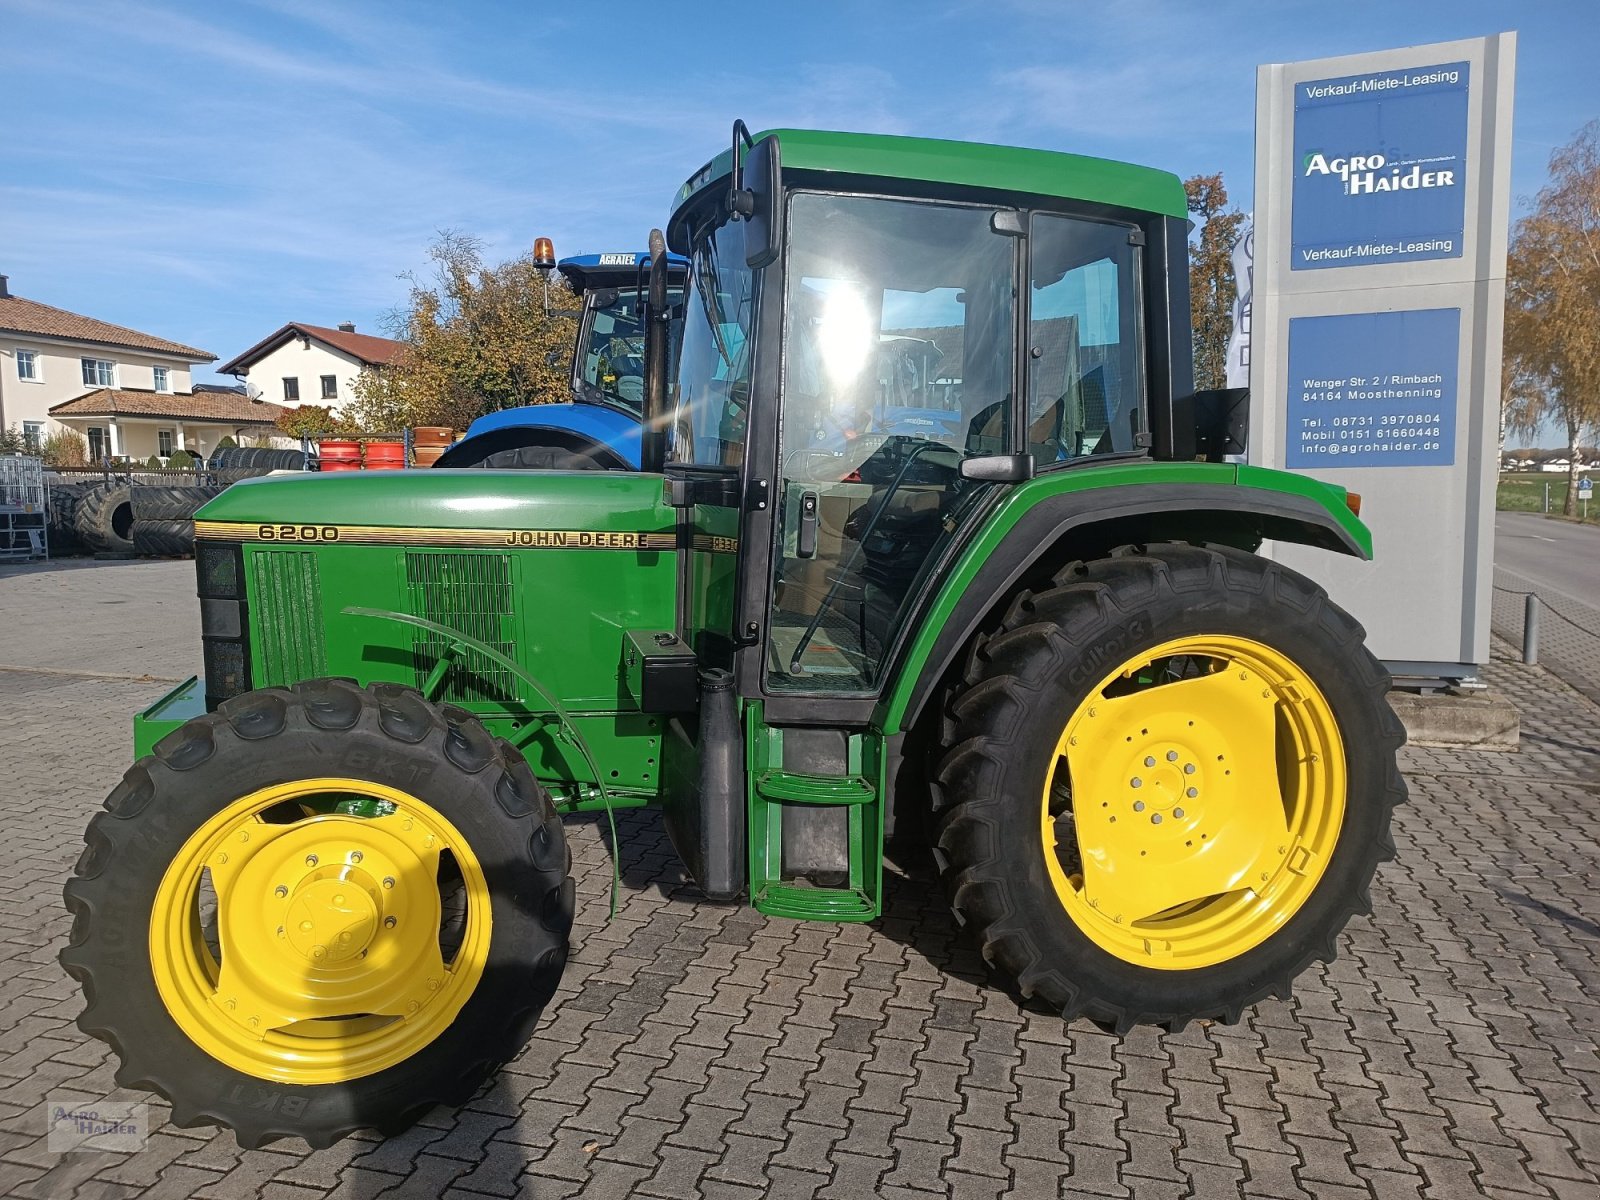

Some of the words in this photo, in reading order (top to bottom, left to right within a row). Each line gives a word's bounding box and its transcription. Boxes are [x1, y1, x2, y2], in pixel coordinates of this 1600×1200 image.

[1306, 70, 1459, 99] Verkauf-Miete-Leasing
[1305, 153, 1385, 181] AGRO
[1302, 239, 1453, 261] Verkauf-Miete-Leasing
[1303, 379, 1346, 390] Wenger
[1350, 377, 1368, 387] Str.
[1372, 376, 1380, 386] 2
[1383, 375, 1388, 386] /
[1391, 374, 1442, 385] Rimbach
[1303, 391, 1342, 402] 84164
[1348, 388, 1441, 400] Moosthenning
[1302, 418, 1327, 428] Tel.
[1333, 416, 1374, 427] 08731
[1381, 414, 1440, 425] 3970804
[1302, 430, 1335, 441] Mobil
[1340, 430, 1371, 440] 0151
[1376, 428, 1440, 438] 61660448
[1301, 441, 1440, 454] info@agrohaider.de
[258, 525, 339, 541] 6200
[506, 531, 567, 546] JOHN
[579, 532, 648, 548] DEERE
